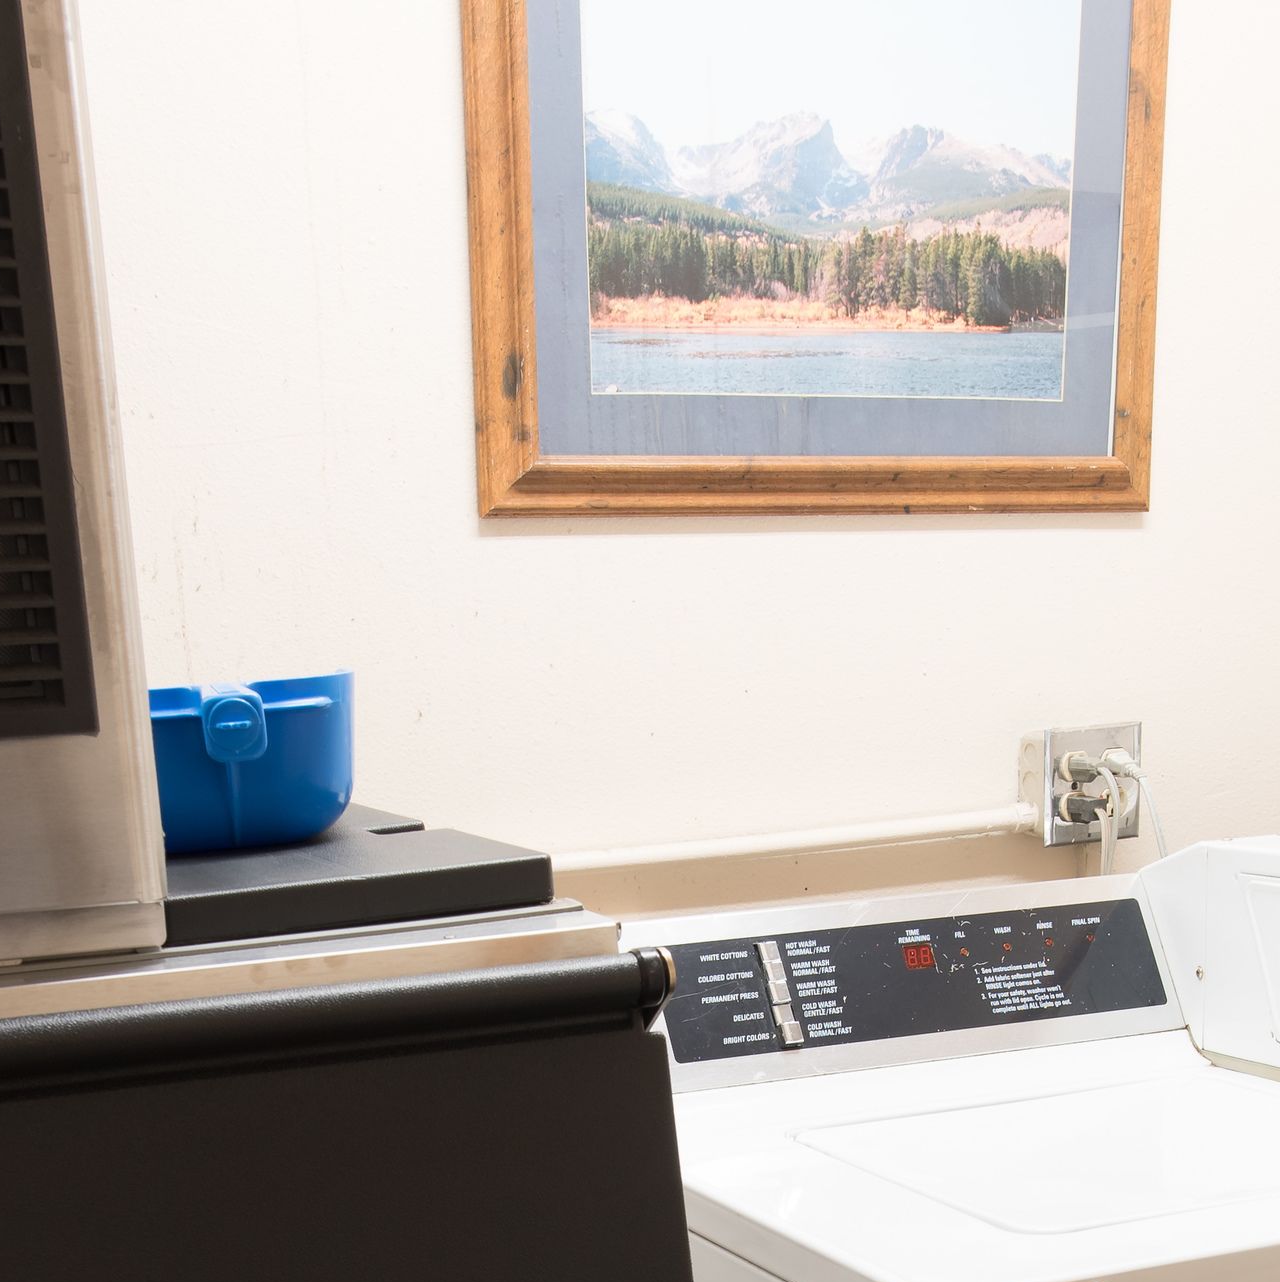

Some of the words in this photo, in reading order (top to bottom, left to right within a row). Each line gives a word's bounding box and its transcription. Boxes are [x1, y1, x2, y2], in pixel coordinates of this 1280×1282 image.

[1036, 921, 1053, 930] RINSE
[1071, 918, 1087, 926] FINAL
[1087, 916, 1100, 925] SPIN
[905, 928, 920, 937] TIME
[954, 931, 966, 939] FILL
[993, 926, 1011, 935] WASH
[785, 941, 799, 950] HOT
[799, 939, 817, 949] WASH
[898, 934, 931, 944] REMAINING
[700, 952, 720, 962] WHITE
[720, 950, 748, 960] COTTONS
[790, 961, 811, 970] WARM
[811, 959, 830, 969] WASH
[698, 973, 725, 984] COLORED
[726, 971, 753, 981] COTTONS
[796, 981, 816, 990] WARM
[816, 979, 836, 989] WASH
[985, 982, 1003, 991] RINSE
[701, 993, 739, 1005] PERMANENT
[739, 991, 759, 1001] PRESS
[801, 1002, 817, 1011] COLD
[817, 1000, 837, 1009] WASH
[733, 1011, 764, 1022] DELICATES
[807, 1022, 823, 1031] COLD
[823, 1020, 842, 1030] WASH
[723, 1035, 746, 1045] BRIGHT
[746, 1032, 770, 1042] COLORS
